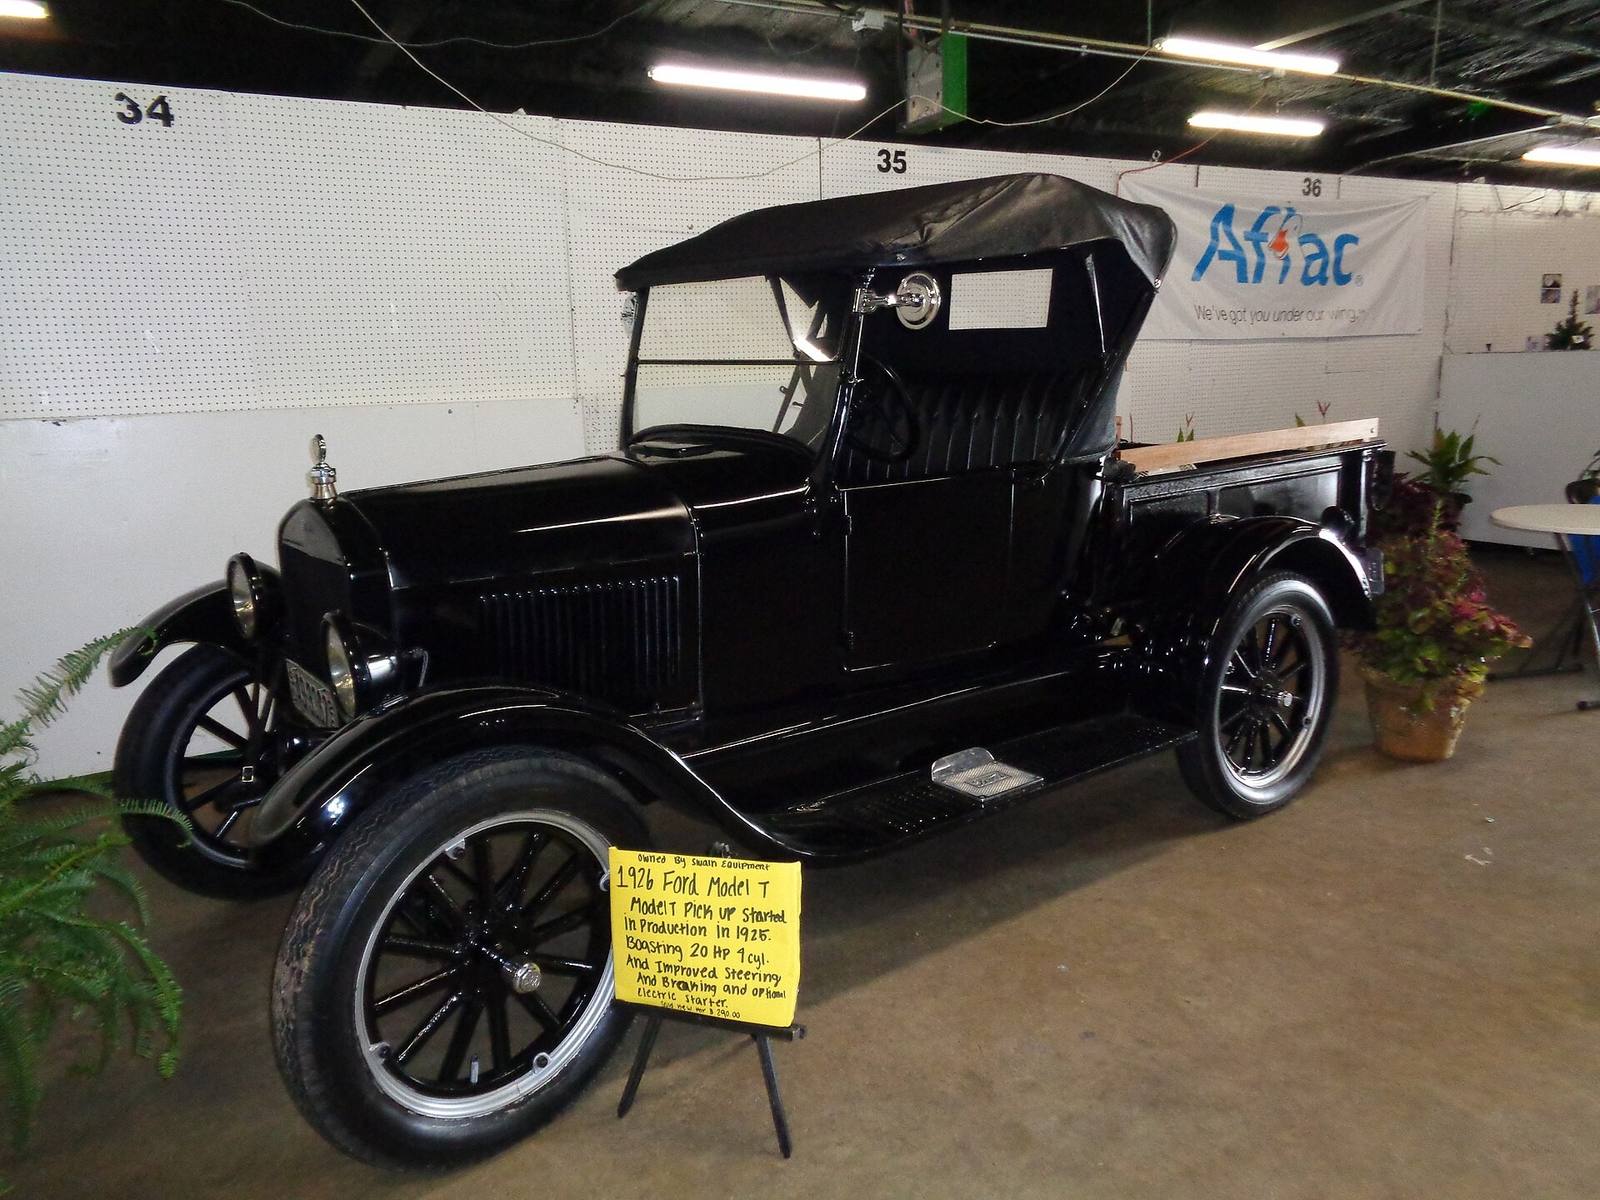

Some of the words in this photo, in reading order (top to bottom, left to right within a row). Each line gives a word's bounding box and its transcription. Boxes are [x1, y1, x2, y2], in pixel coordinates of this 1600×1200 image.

[114, 92, 174, 127] 34
[877, 149, 907, 173] 35
[1302, 177, 1322, 197] 36
[1191, 203, 1360, 287] Aflac
[1194, 305, 1228, 321] We've
[1229, 307, 1247, 325] got
[1250, 307, 1270, 325] you
[1272, 306, 1304, 322] under
[674, 856, 686, 869] By
[616, 865, 654, 890] 1926
[663, 870, 699, 896] Ford
[707, 875, 750, 898] Model
[758, 881, 770, 898] T
[639, 918, 707, 937] Production
[625, 934, 683, 963] Boasting
[690, 943, 708, 958] 20
[626, 954, 650, 970] And
[655, 960, 718, 979] Improved
[636, 971, 657, 987] And
[723, 983, 748, 996] and
